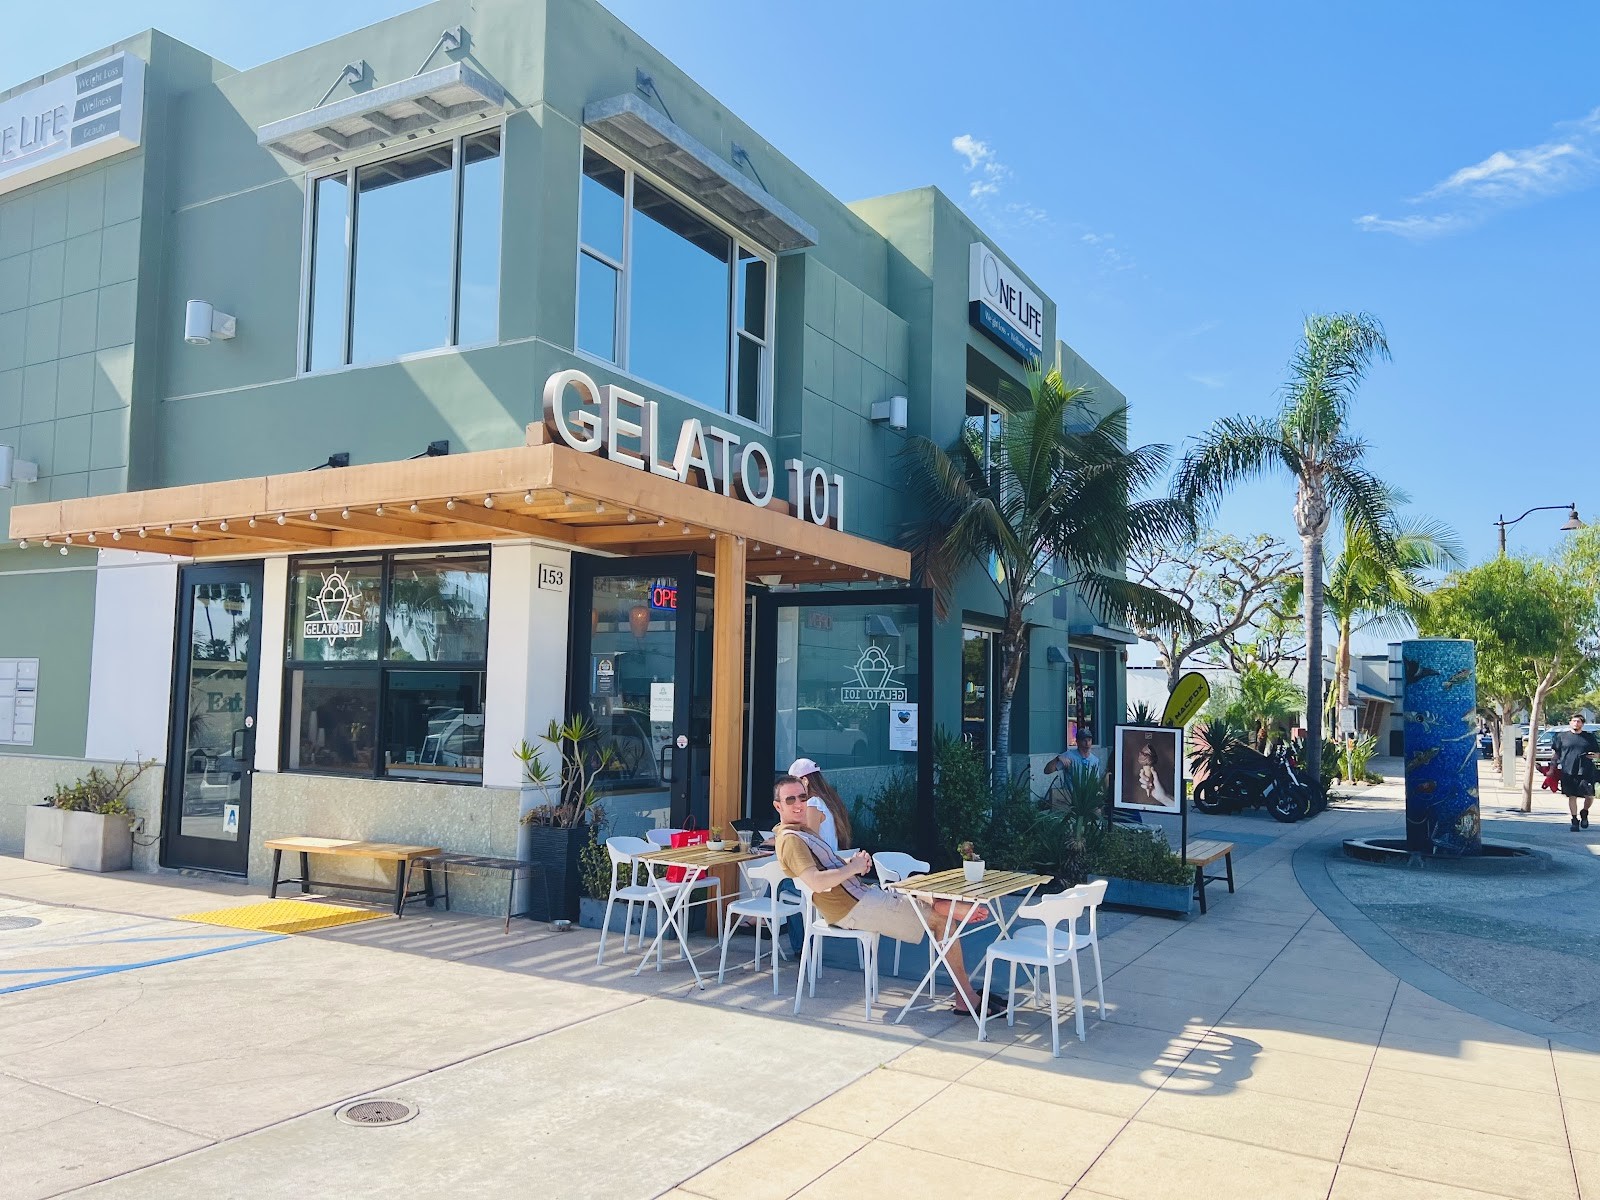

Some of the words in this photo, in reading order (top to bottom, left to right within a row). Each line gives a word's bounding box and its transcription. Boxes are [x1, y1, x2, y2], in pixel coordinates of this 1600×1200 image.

[78, 72, 102, 90] Weight
[104, 66, 119, 80] Loss
[81, 95, 112, 113] Wellness
[20, 105, 64, 149] LIFE
[1018, 291, 1042, 338] LIFE
[543, 369, 775, 507] GELATO
[785, 458, 844, 532] 101
[542, 568, 563, 586] 153
[653, 587, 678, 609] OPE
[306, 623, 339, 635] GELATO
[344, 622, 360, 634] 101
